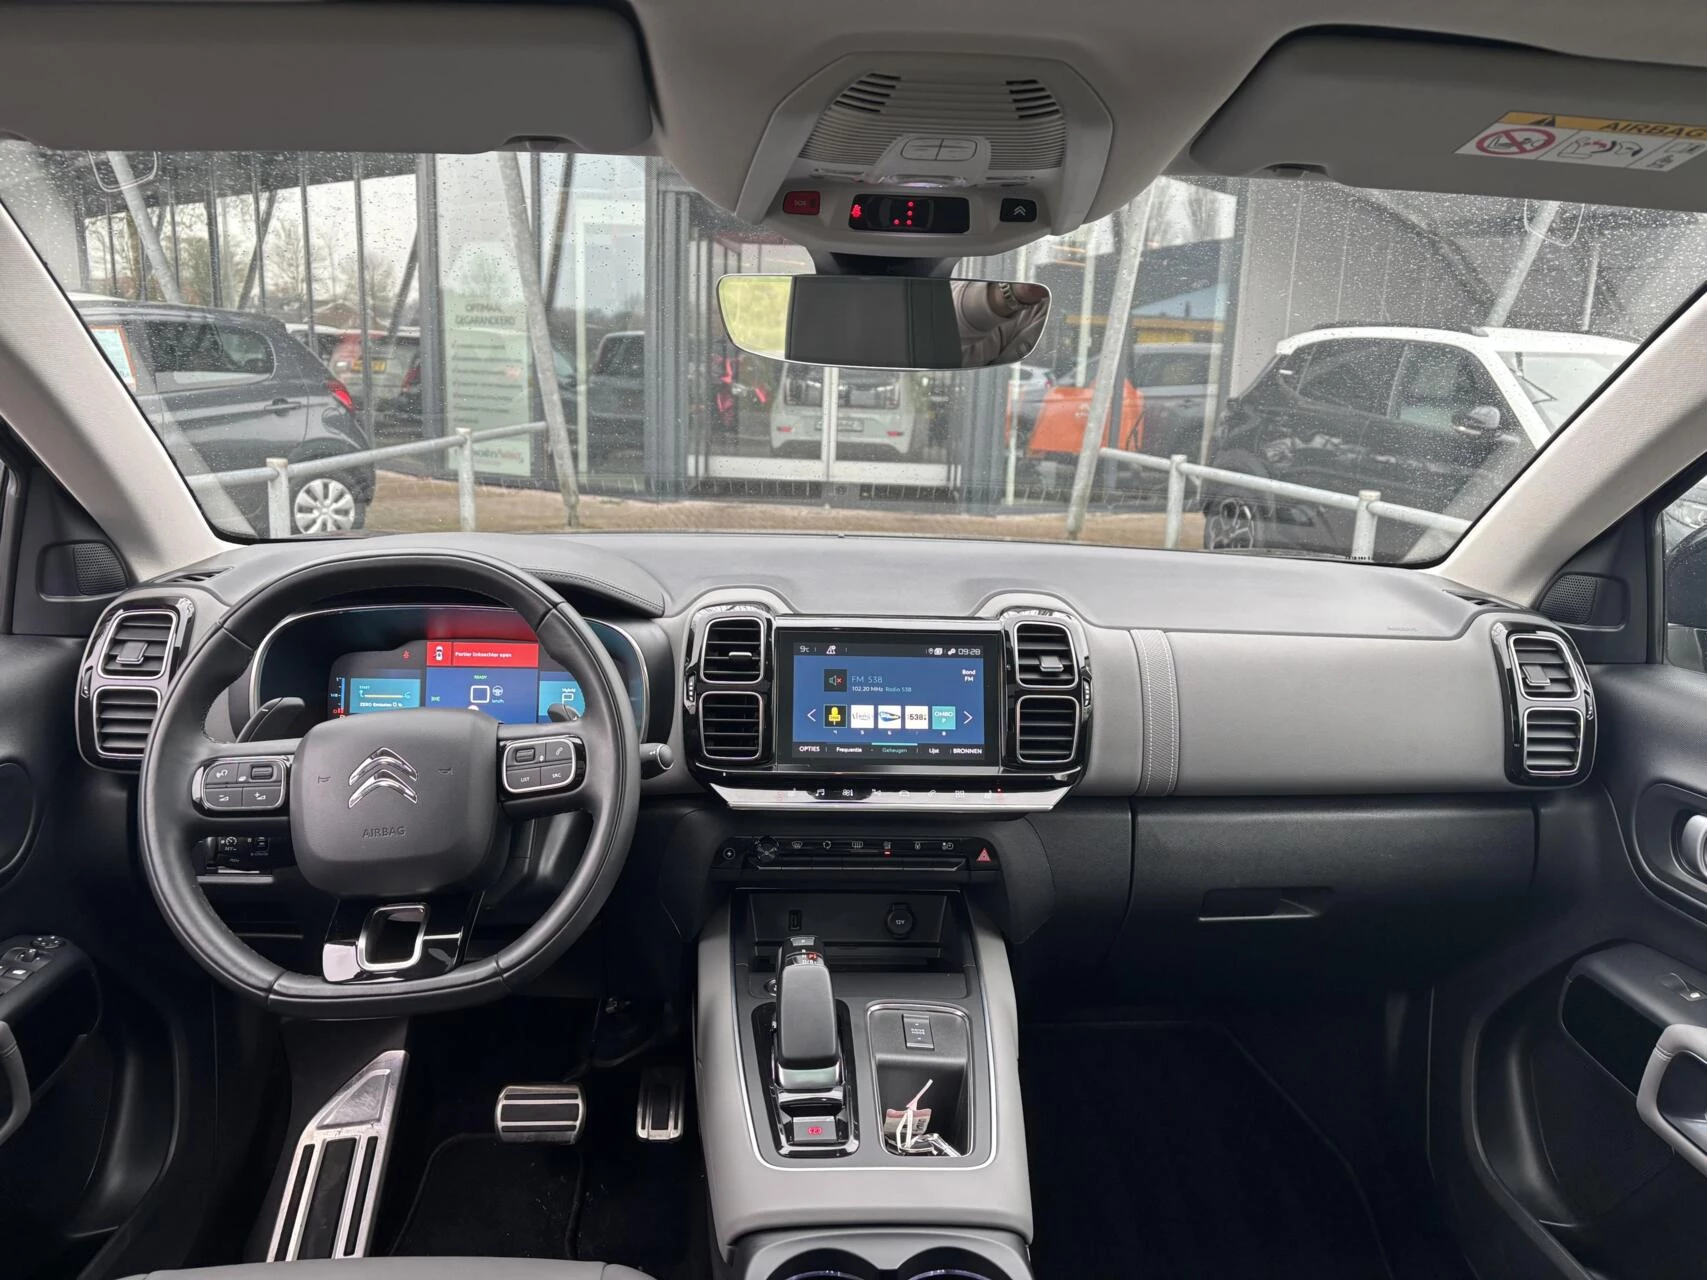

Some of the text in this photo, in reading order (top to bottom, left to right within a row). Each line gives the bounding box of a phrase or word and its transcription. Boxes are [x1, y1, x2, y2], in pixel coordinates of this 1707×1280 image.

[1601, 121, 1707, 138] AIRBAG
[851, 675, 883, 684] FM 538
[361, 825, 407, 839] AIRBAG
